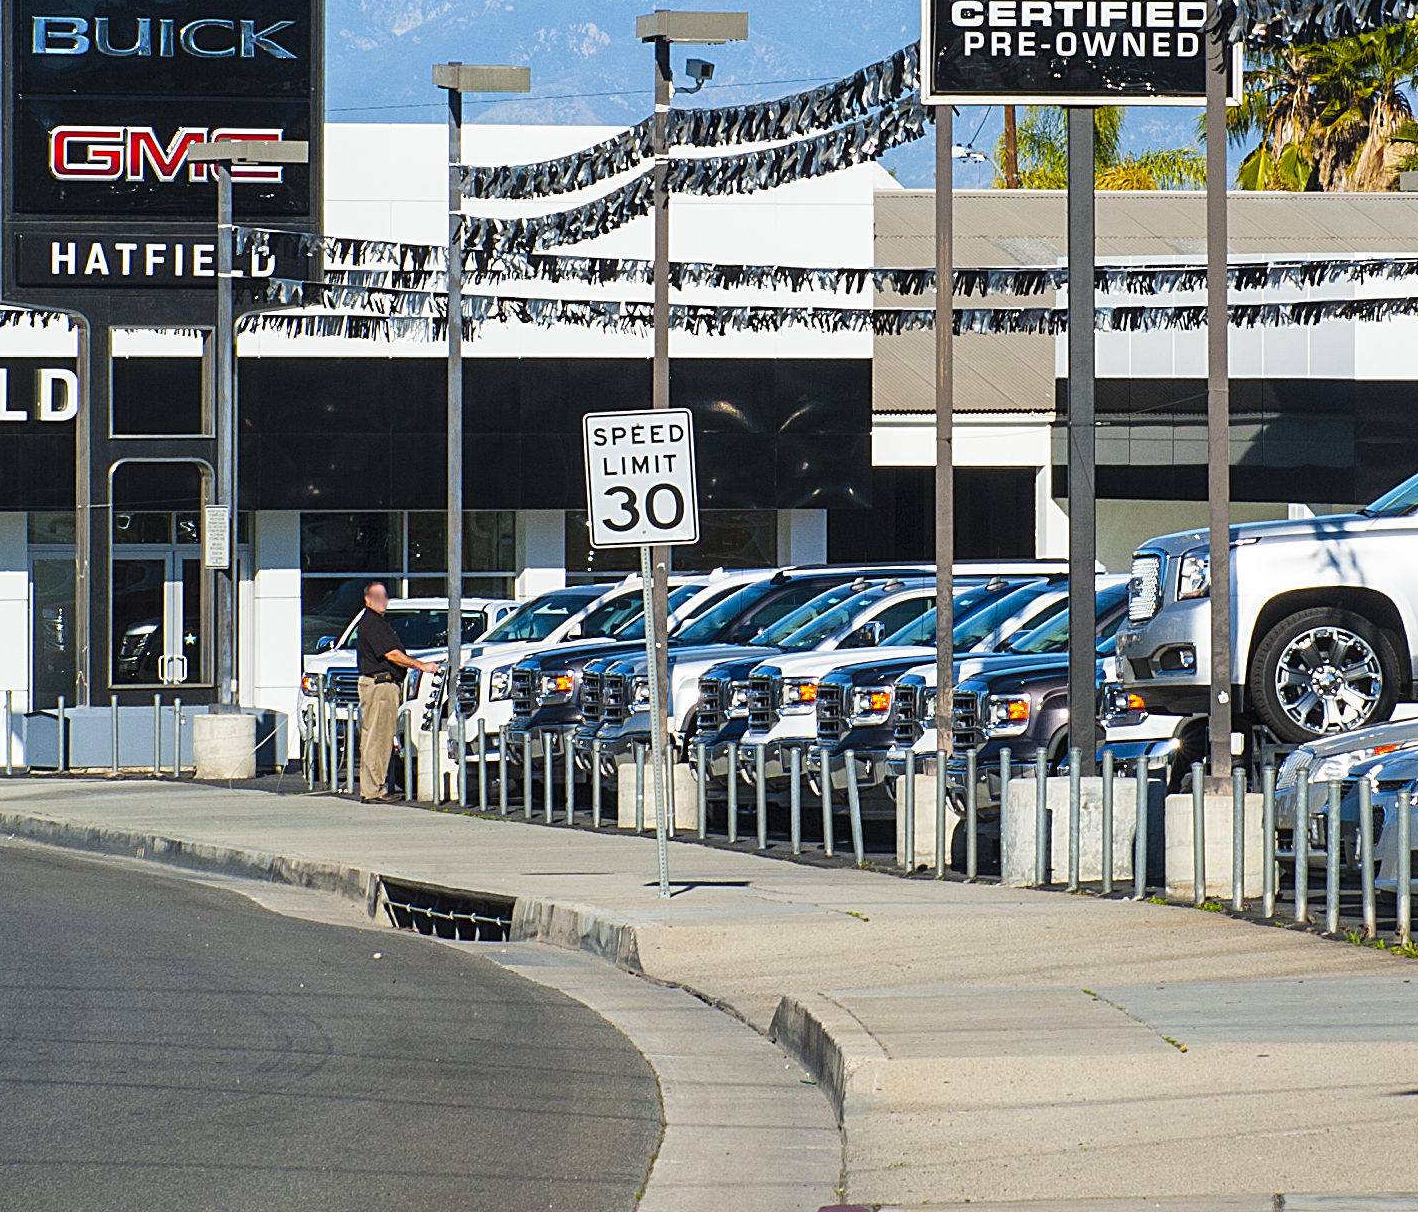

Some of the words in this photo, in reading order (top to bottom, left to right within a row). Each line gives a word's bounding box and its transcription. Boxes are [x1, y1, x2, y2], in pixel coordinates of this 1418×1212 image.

[951, 0, 1207, 28] CERTIFIED
[31, 15, 298, 59] BUICK
[964, 32, 1199, 58] PRE-OWNED
[593, 424, 684, 446] SPEED
[603, 454, 677, 476] LIMIT
[601, 482, 685, 533] 30
